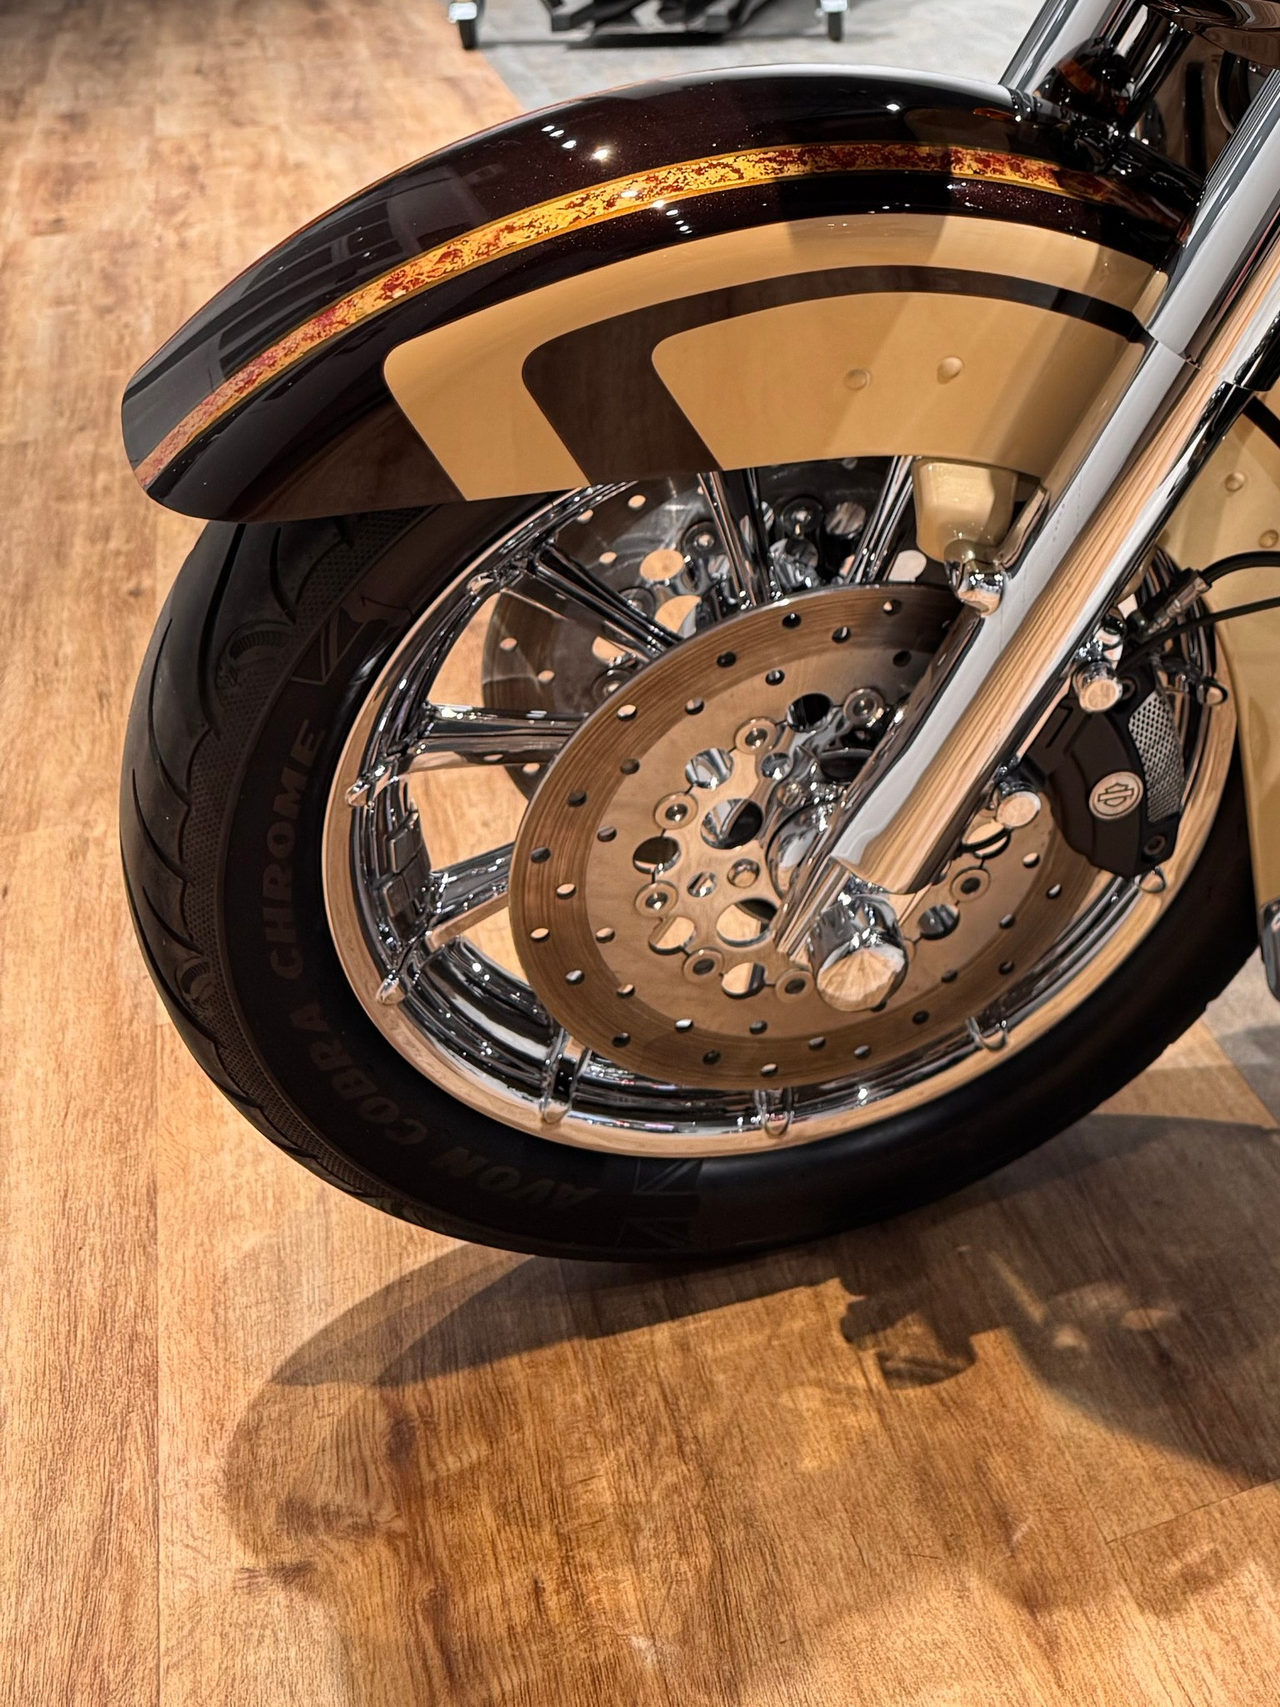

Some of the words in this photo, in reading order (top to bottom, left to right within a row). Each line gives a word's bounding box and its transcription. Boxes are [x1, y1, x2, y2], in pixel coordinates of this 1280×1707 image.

[262, 718, 326, 981] CHROME
[290, 1000, 428, 1147] COBRA
[428, 1145, 602, 1211] AVON
